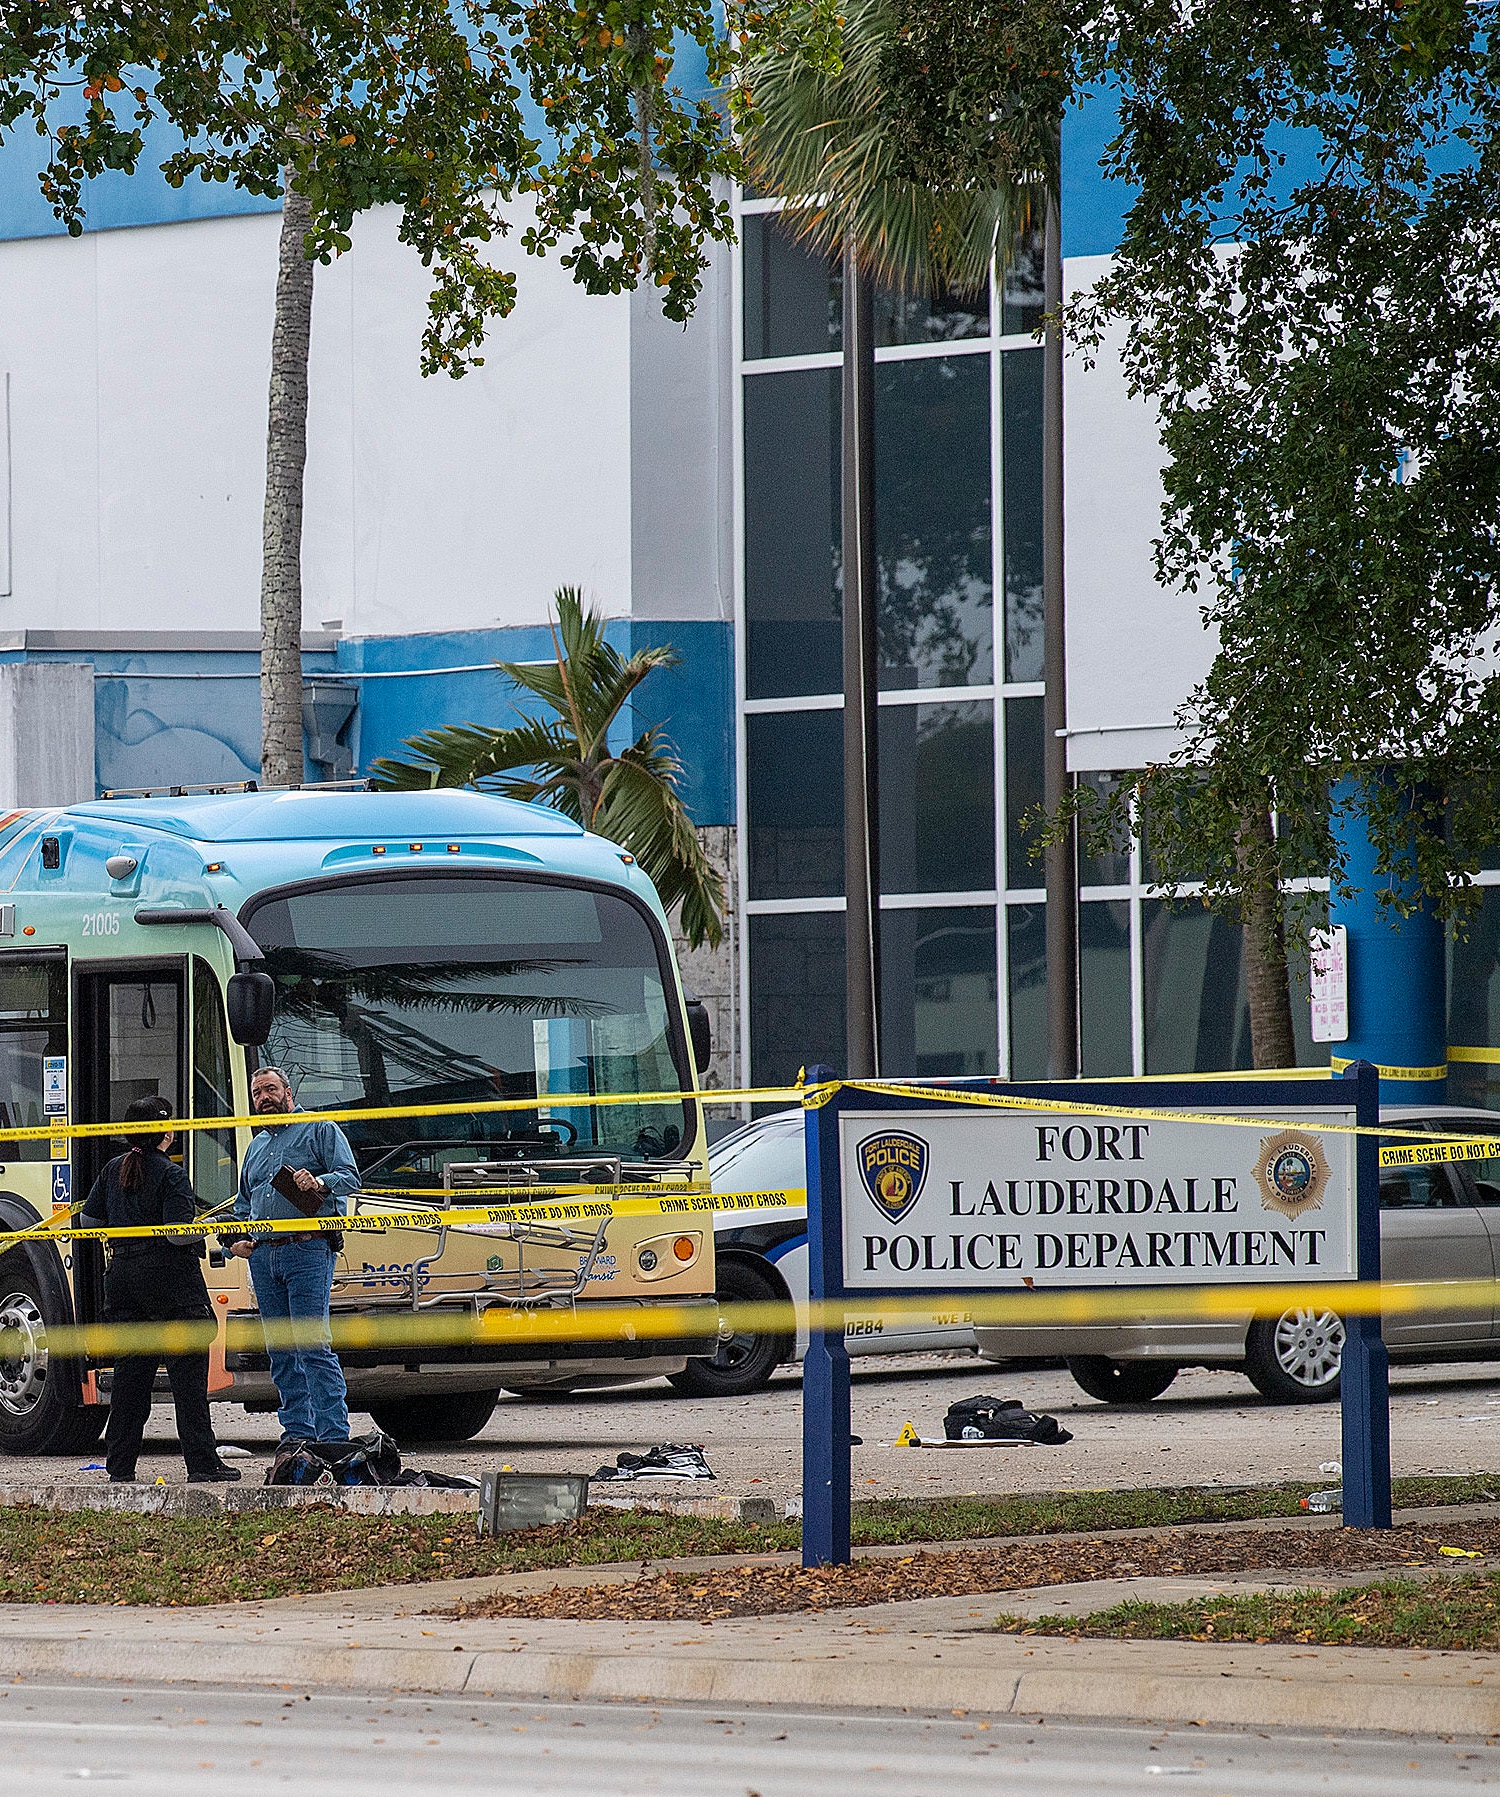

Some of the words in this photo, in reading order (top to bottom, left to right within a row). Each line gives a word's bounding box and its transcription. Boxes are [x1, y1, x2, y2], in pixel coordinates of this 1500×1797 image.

[82, 912, 120, 936] 21005
[866, 1142, 880, 1155] FORT
[881, 1139, 920, 1154] LAUDERDALE
[1035, 1125, 1150, 1162] FORT
[1382, 1149, 1414, 1164] CRIME
[1416, 1147, 1447, 1162] SCENE
[1450, 1145, 1463, 1159] DO
[1466, 1143, 1485, 1158] NOT
[866, 1148, 920, 1171] POLICE
[1267, 1157, 1276, 1182] FORT
[1277, 1144, 1316, 1181] LAUDERDALE
[949, 1178, 1238, 1217] LAUDERDALE
[1276, 1191, 1307, 1203] POLICE
[318, 1217, 347, 1230] CRIME
[349, 1216, 377, 1229] SCENE
[379, 1216, 391, 1228] DO
[393, 1215, 409, 1226] NOT
[411, 1213, 442, 1225] CROSS
[487, 1209, 517, 1223] CRIME
[518, 1208, 548, 1221] SCENE
[549, 1206, 563, 1219] DO
[565, 1205, 582, 1218] NOT
[583, 1203, 613, 1216] CROSS
[660, 1199, 689, 1213] CRIME
[692, 1197, 720, 1211] SCENE
[723, 1196, 735, 1209] DO
[737, 1195, 755, 1207] NOT
[757, 1193, 787, 1206] CROSS
[862, 1234, 1023, 1272] POLICE
[1034, 1230, 1326, 1269] DEPARTMENT
[904, 1429, 910, 1439] 2
